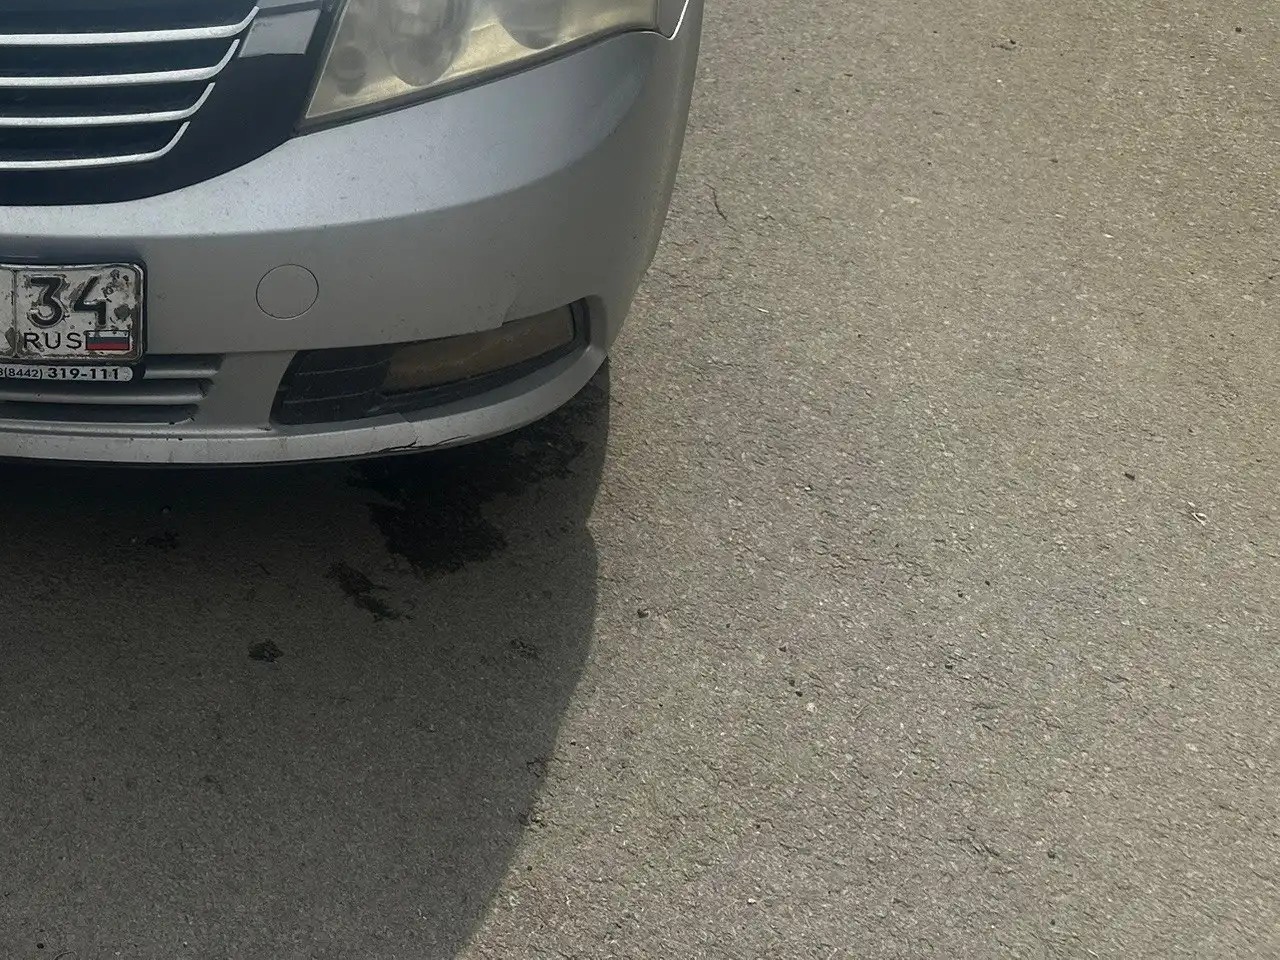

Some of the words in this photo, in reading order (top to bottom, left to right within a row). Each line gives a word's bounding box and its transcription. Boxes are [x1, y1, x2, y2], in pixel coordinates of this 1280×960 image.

[29, 275, 108, 329] 34
[23, 332, 82, 350] RUS
[47, 367, 119, 381] 319-111
